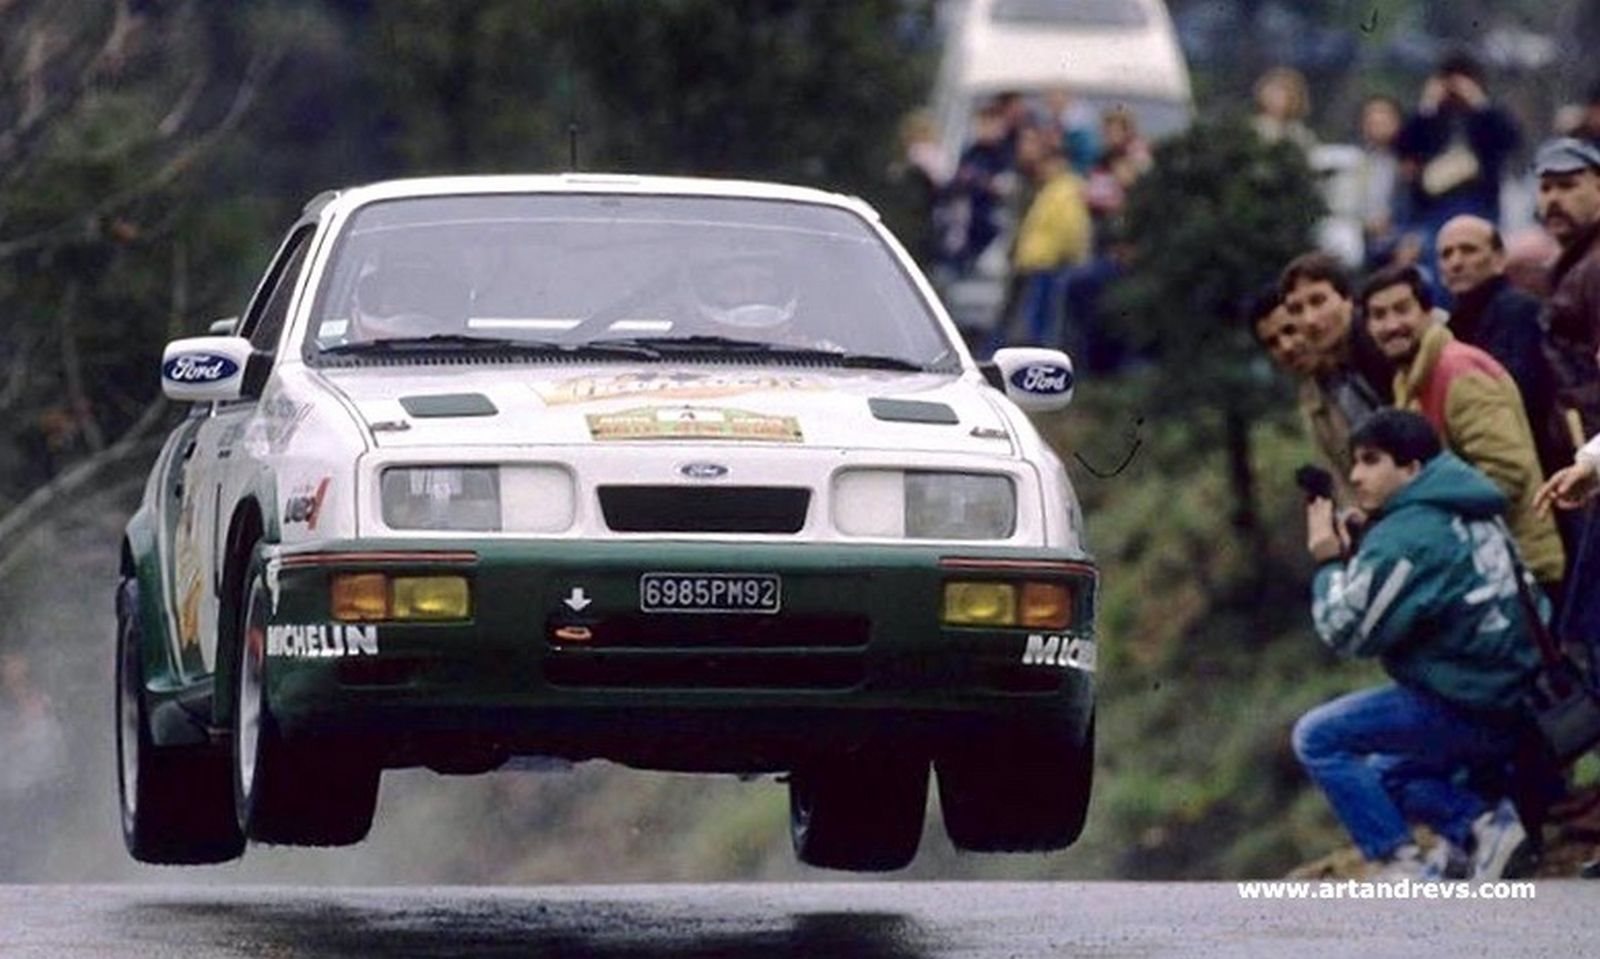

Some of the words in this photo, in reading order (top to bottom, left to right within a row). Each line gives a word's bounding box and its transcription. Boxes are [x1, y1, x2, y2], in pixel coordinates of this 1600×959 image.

[171, 355, 224, 380] Ford
[1023, 366, 1067, 390] Ford
[646, 579, 775, 606] 6985PM92
[266, 624, 379, 657] MICHELIN
